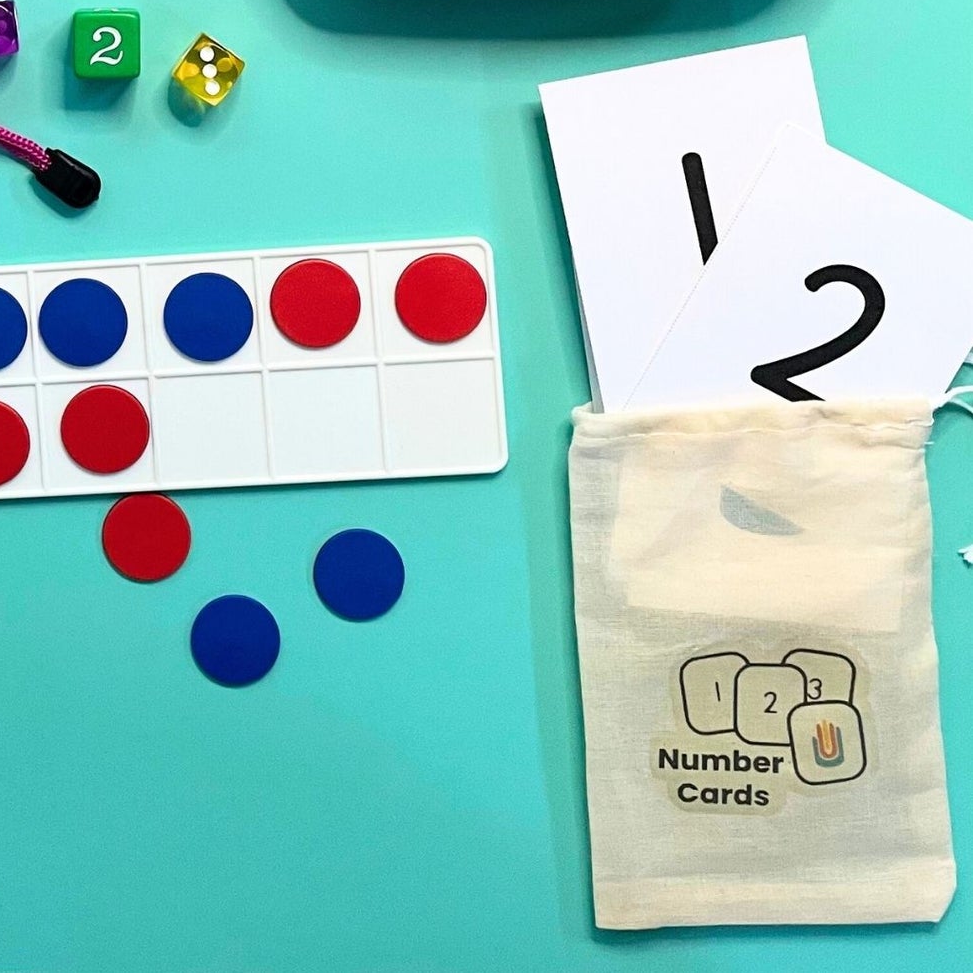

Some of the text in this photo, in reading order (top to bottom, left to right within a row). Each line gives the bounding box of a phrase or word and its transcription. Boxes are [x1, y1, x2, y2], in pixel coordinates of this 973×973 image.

[89, 26, 124, 66] 2
[682, 152, 719, 266] 1
[750, 264, 886, 402] 2
[806, 677, 824, 700] 3
[763, 691, 779, 714] 2
[657, 748, 785, 774] Number
[676, 782, 771, 807] Cards
